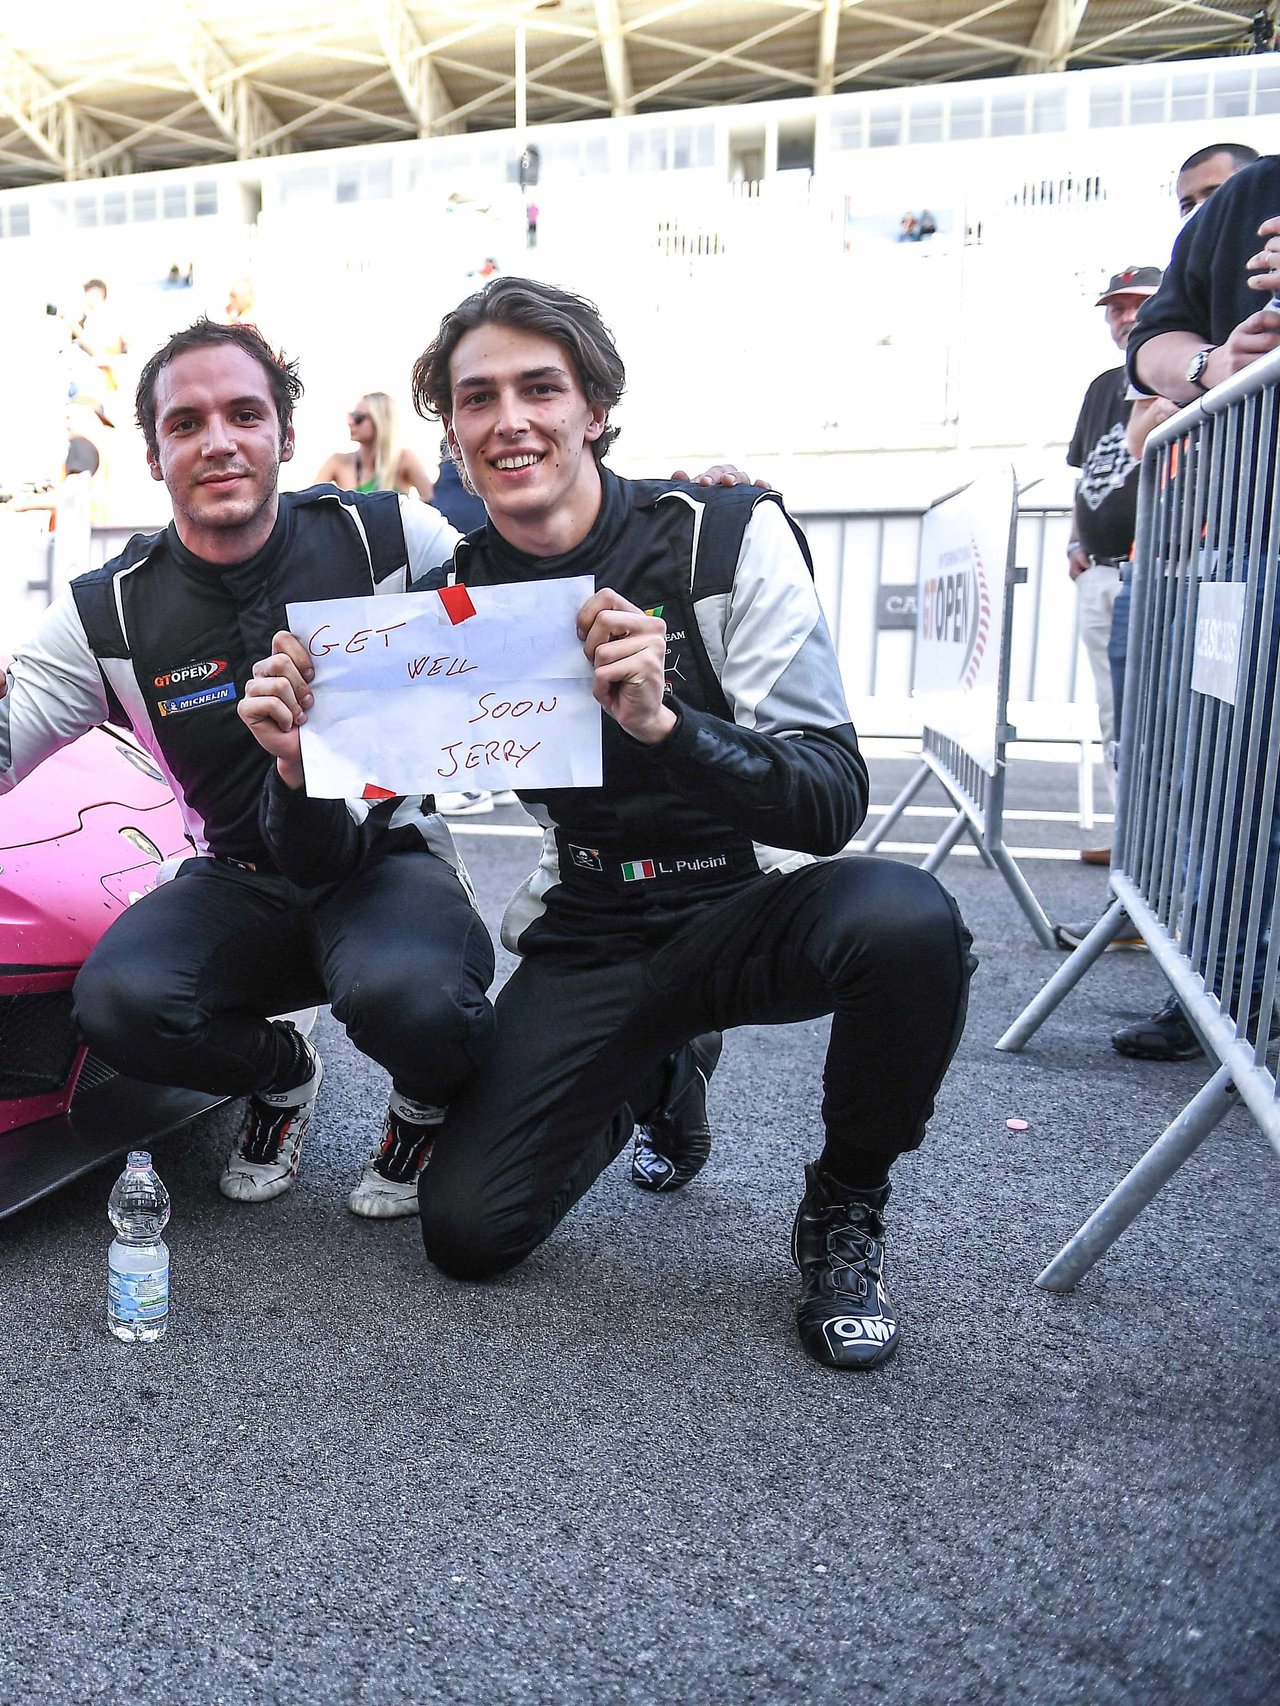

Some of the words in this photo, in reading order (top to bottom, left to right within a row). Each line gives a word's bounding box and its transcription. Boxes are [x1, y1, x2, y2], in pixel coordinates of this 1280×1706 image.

[308, 622, 407, 657] GET
[664, 630, 686, 642] EAM
[154, 664, 208, 688] GTOPEN
[407, 656, 478, 680] WELL
[180, 689, 229, 709] MICHELIN
[468, 692, 558, 724] SOON
[437, 740, 542, 778] JERRY
[658, 862, 673, 873] L.
[676, 854, 727, 872] Pulcini
